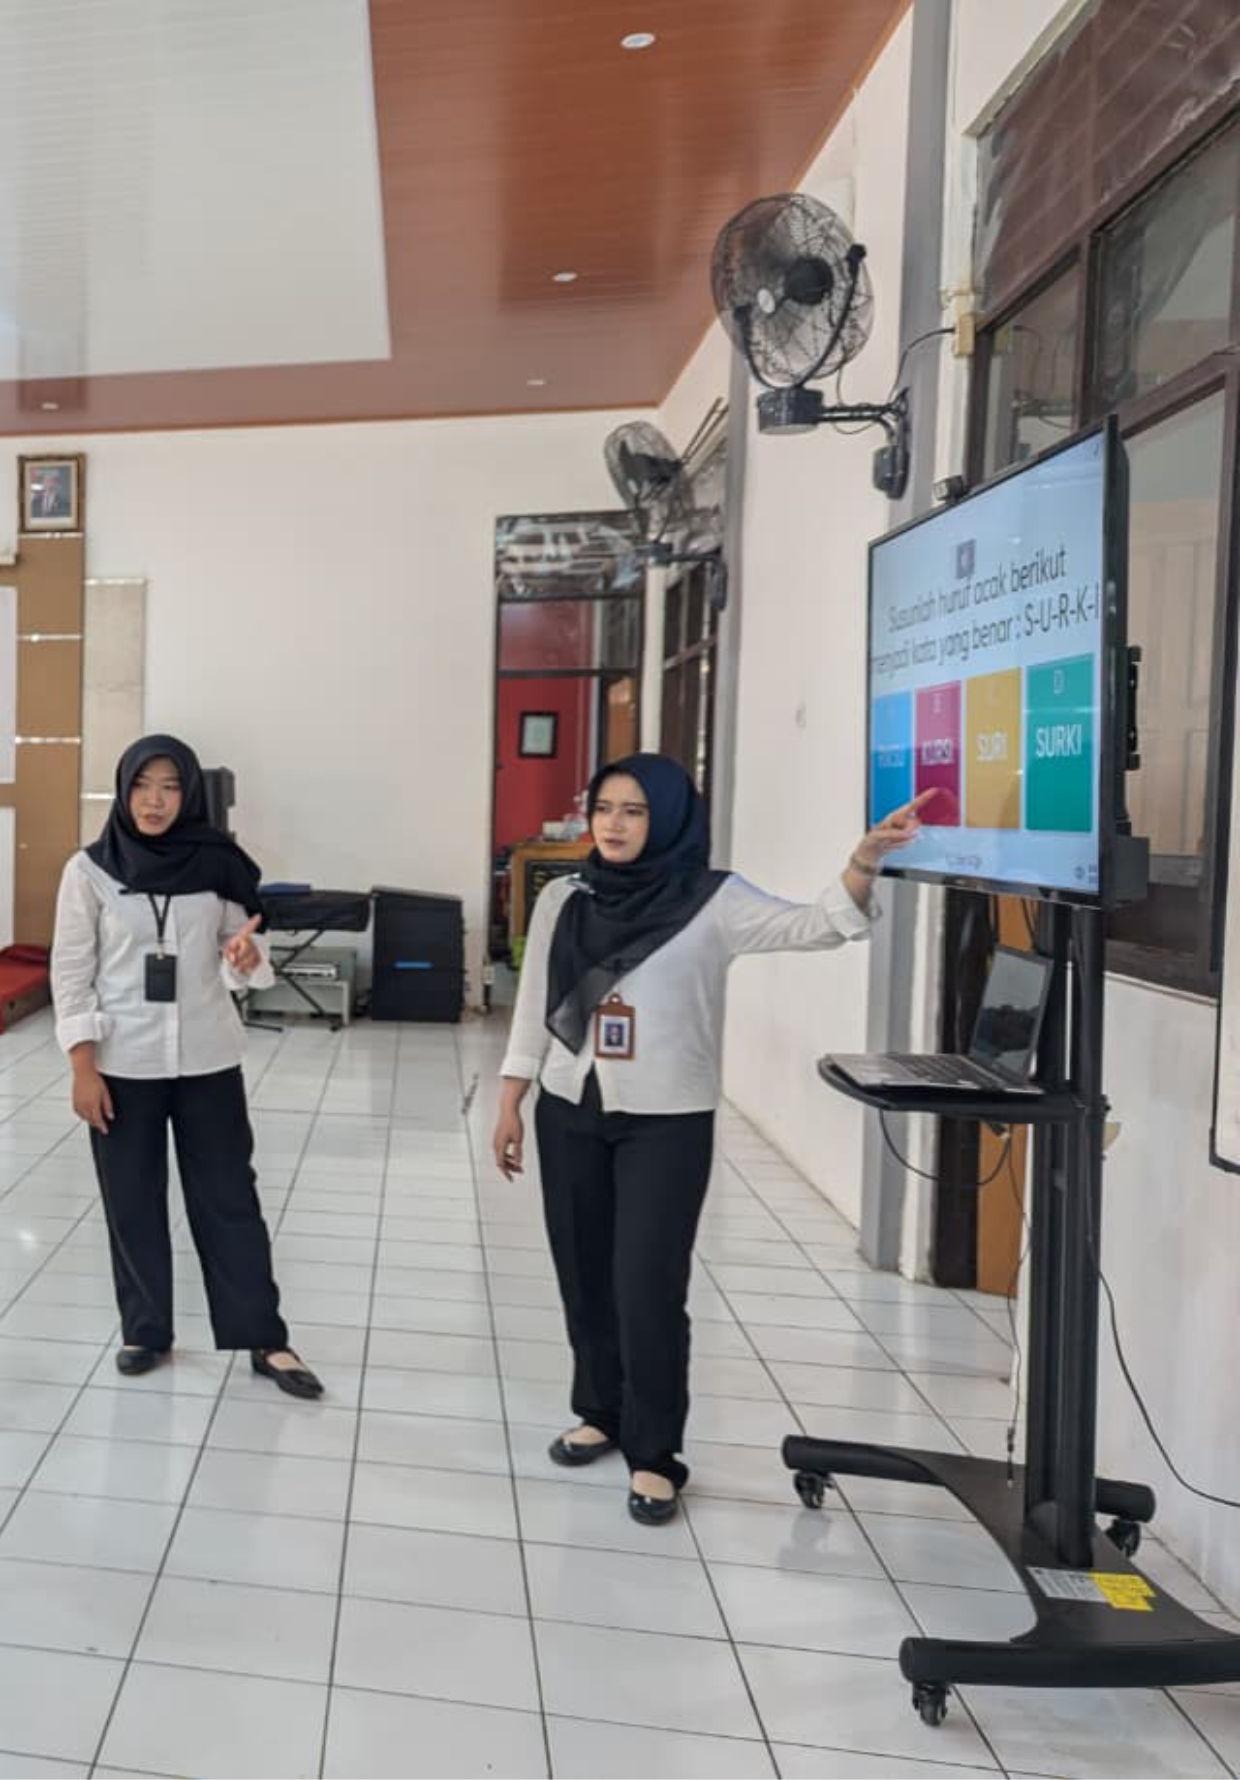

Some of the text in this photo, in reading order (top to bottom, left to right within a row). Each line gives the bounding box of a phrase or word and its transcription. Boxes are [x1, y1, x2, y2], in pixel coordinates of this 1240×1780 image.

[974, 562, 1007, 605] acak
[1010, 545, 1066, 593] berikut
[911, 634, 937, 665] kata
[938, 629, 970, 667] yang
[972, 618, 1013, 650] benar
[1024, 582, 1100, 637] S-U-R-K-I
[1035, 723, 1083, 759] SURKI
